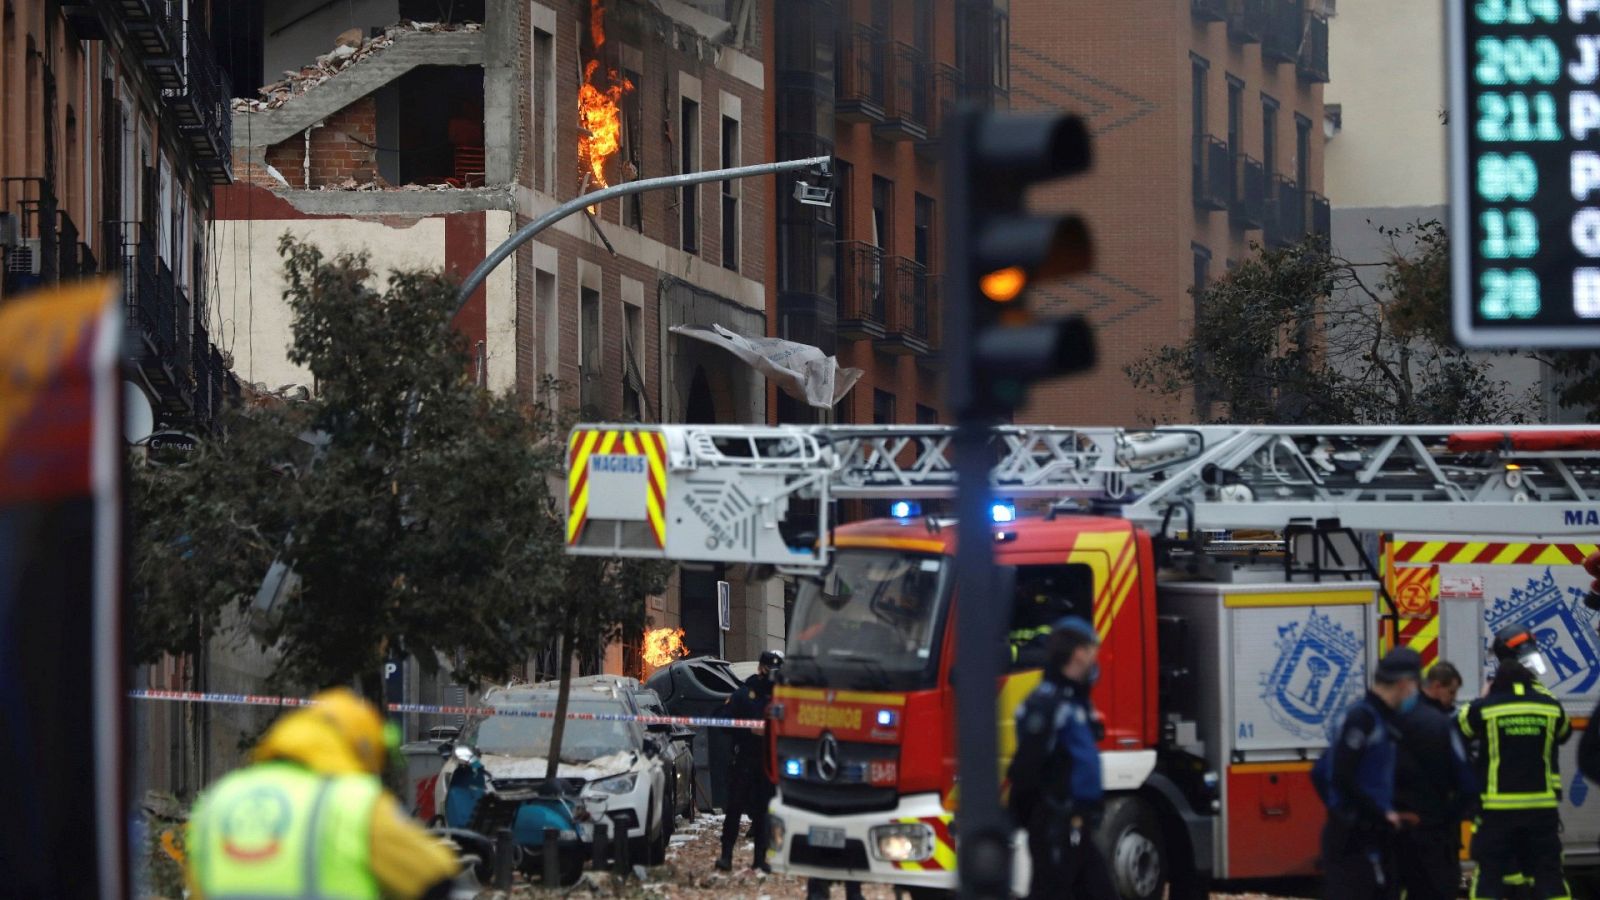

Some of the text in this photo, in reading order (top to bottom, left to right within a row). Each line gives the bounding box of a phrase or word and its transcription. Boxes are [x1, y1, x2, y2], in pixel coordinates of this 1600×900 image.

[1475, 35, 1560, 85] 200
[1476, 91, 1562, 141] 211
[591, 455, 644, 473] MAGIRUS
[683, 494, 736, 549] MAGIRUS
[1564, 510, 1600, 526] MA
[385, 663, 397, 679] P
[1238, 723, 1254, 738] A1
